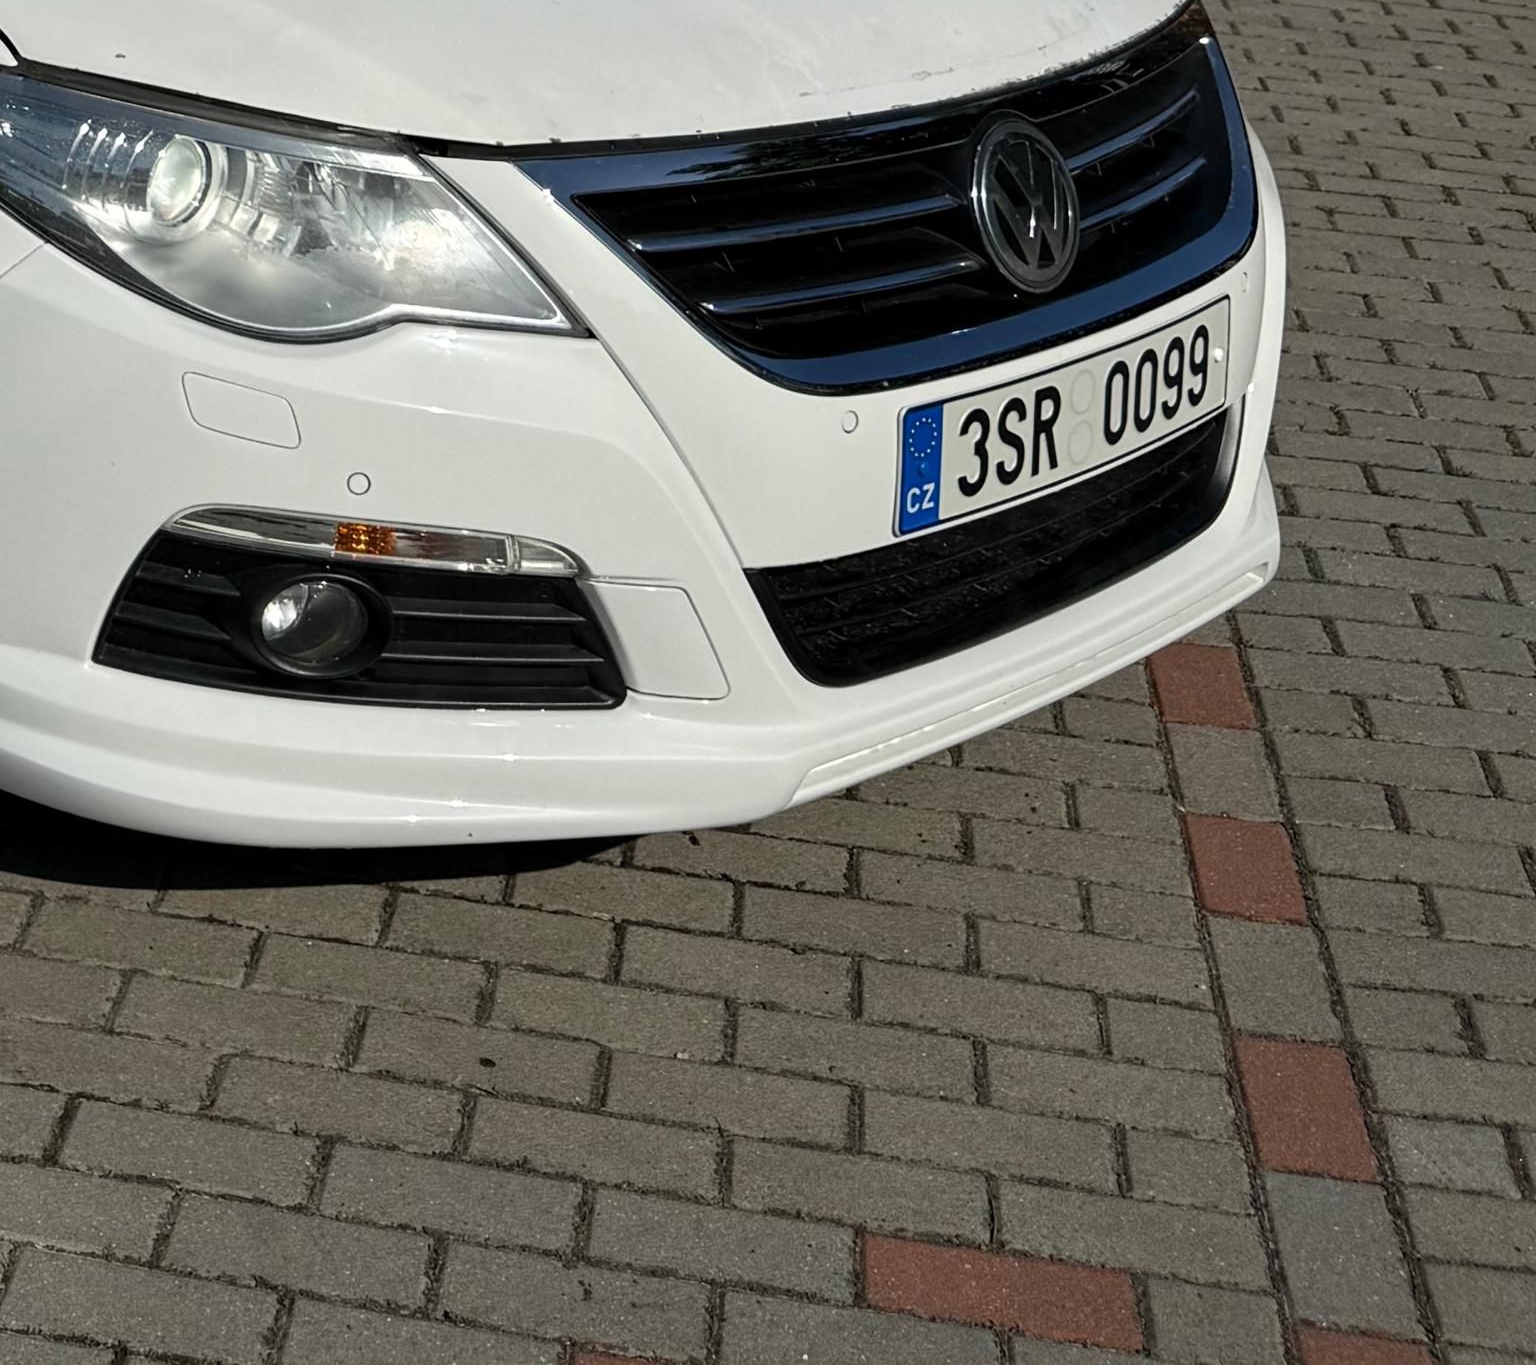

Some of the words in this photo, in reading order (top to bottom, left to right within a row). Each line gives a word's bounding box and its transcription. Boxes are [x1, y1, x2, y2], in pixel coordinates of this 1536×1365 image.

[957, 385, 1062, 497] 3SR
[1103, 324, 1209, 446] 0099
[906, 482, 935, 514] CZ
